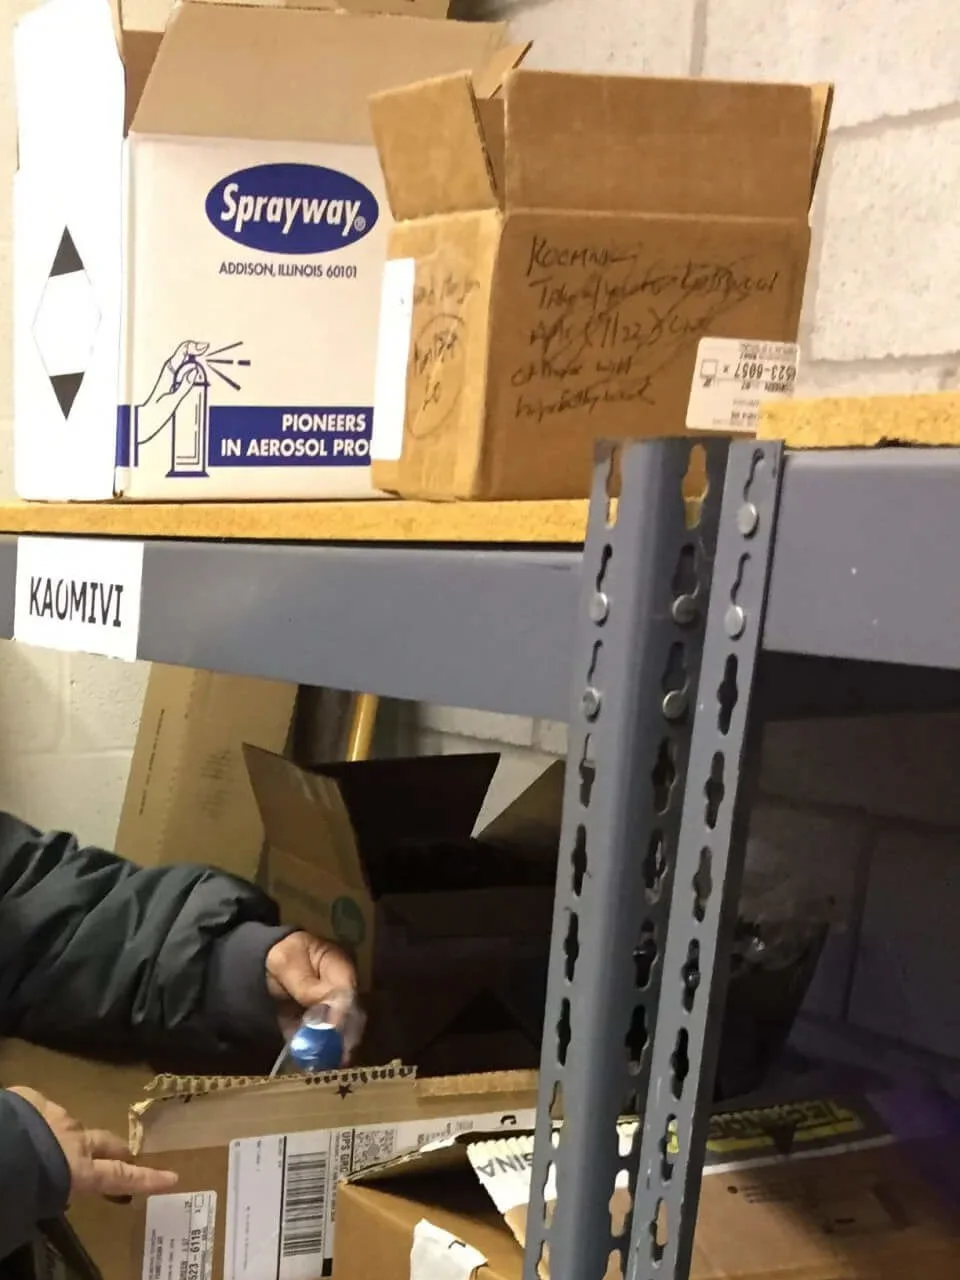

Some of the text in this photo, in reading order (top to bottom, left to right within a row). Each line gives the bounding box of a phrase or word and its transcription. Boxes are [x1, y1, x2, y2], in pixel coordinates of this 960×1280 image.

[219, 261, 357, 279] ADDISON, ILLINOIS 60101
[282, 413, 367, 433] PIONEERS
[221, 438, 372, 457] IN AEROSOL PRO
